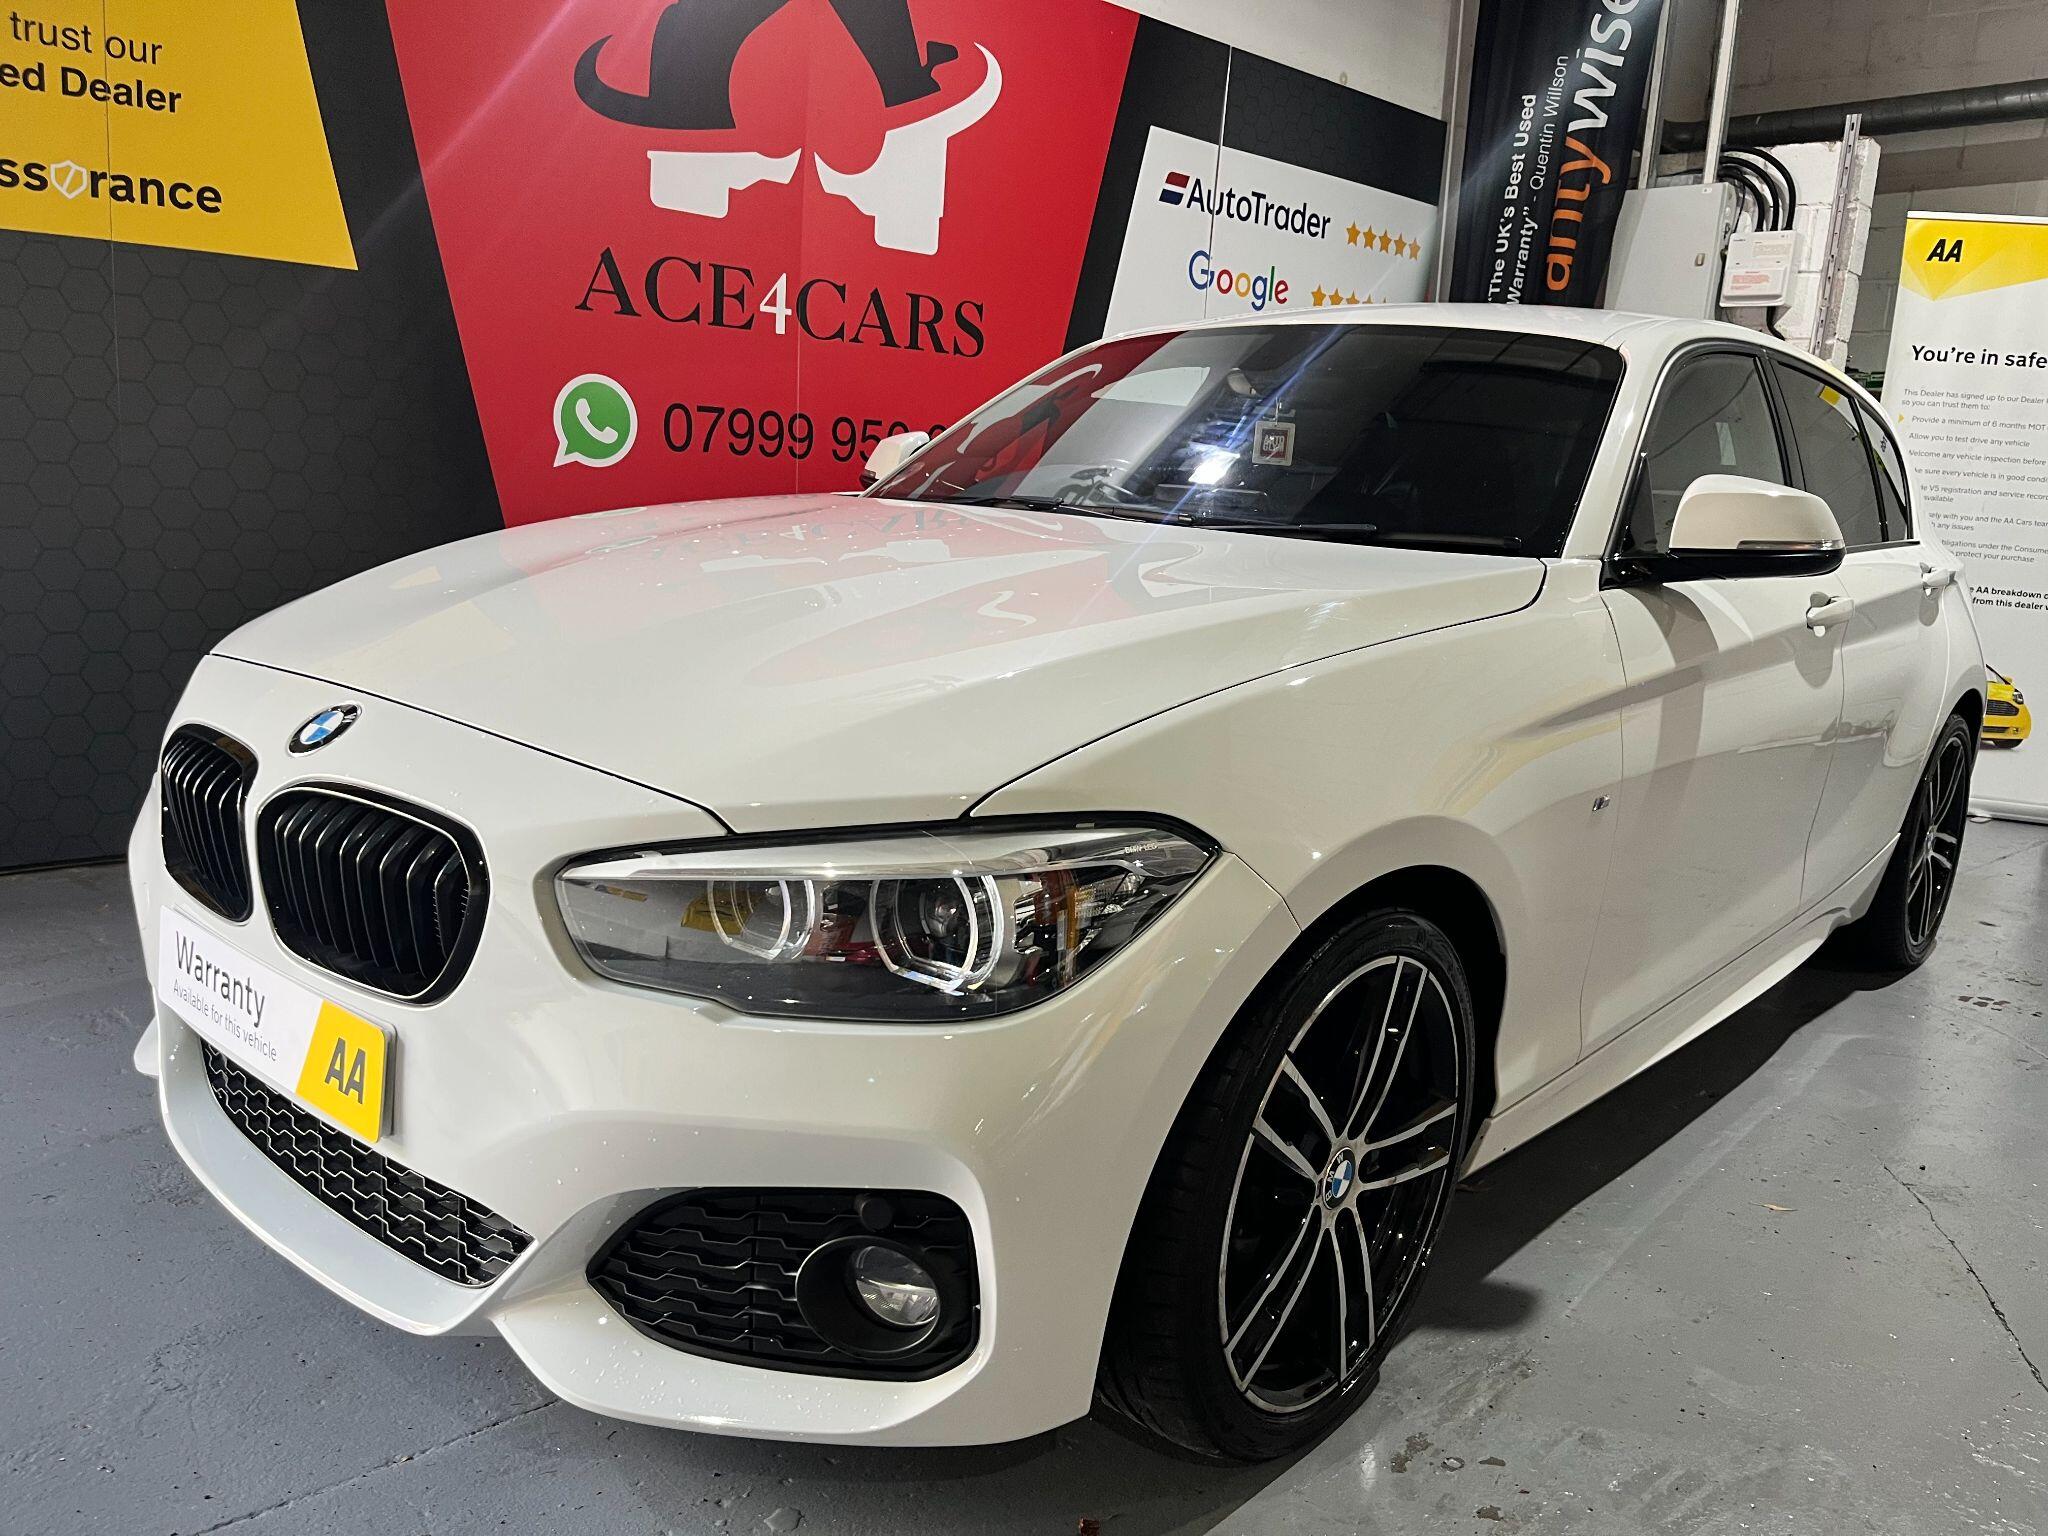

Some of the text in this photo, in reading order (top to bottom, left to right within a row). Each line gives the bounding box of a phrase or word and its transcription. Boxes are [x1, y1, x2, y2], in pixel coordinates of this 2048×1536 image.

[10, 11, 162, 65] trust our
[61, 66, 182, 113] Dealer
[1513, 94, 1537, 147] Used
[1529, 123, 1555, 190] Quentin
[1542, 55, 1569, 117] Willson
[1504, 153, 1526, 199] Best
[1186, 178, 1331, 239] AutoTrader
[1495, 206, 1515, 253] UK's
[1926, 239, 1963, 262] AA
[1188, 249, 1289, 311] Google
[574, 246, 985, 358] ACE4CARS
[1911, 345, 2048, 369] You're in safe
[1904, 388, 1919, 396] This
[1920, 389, 1944, 397] Dealer
[2020, 395, 2044, 403] Dealer
[1961, 402, 1978, 410] them
[663, 403, 814, 459] 07999
[1909, 432, 1929, 440] Allow
[2005, 439, 2030, 447] vehicle
[1911, 415, 1940, 423] Provide
[1947, 419, 1980, 427] minimum
[1999, 422, 2026, 430] months
[2028, 423, 2046, 431] MOT
[1956, 453, 1982, 461] vehicle
[1984, 455, 2021, 464] inspection
[2023, 457, 2047, 465] before
[1941, 486, 1982, 495] registration
[1998, 491, 2025, 499] service
[1943, 512, 1958, 520] with
[2003, 517, 2014, 525] AA
[2015, 518, 2033, 526] Cars
[1951, 523, 1974, 531] issues
[1955, 551, 1982, 559] protect
[2000, 554, 2035, 563] purchase
[1972, 596, 1994, 606] from
[1996, 599, 2013, 607] this
[2014, 601, 2044, 610] dealer
[1975, 586, 1989, 594] AA
[1991, 587, 2042, 599] breakdown
[175, 930, 265, 1028] Warranty
[173, 978, 277, 1062] Available for this vehicle
[324, 1037, 367, 1105] AA
